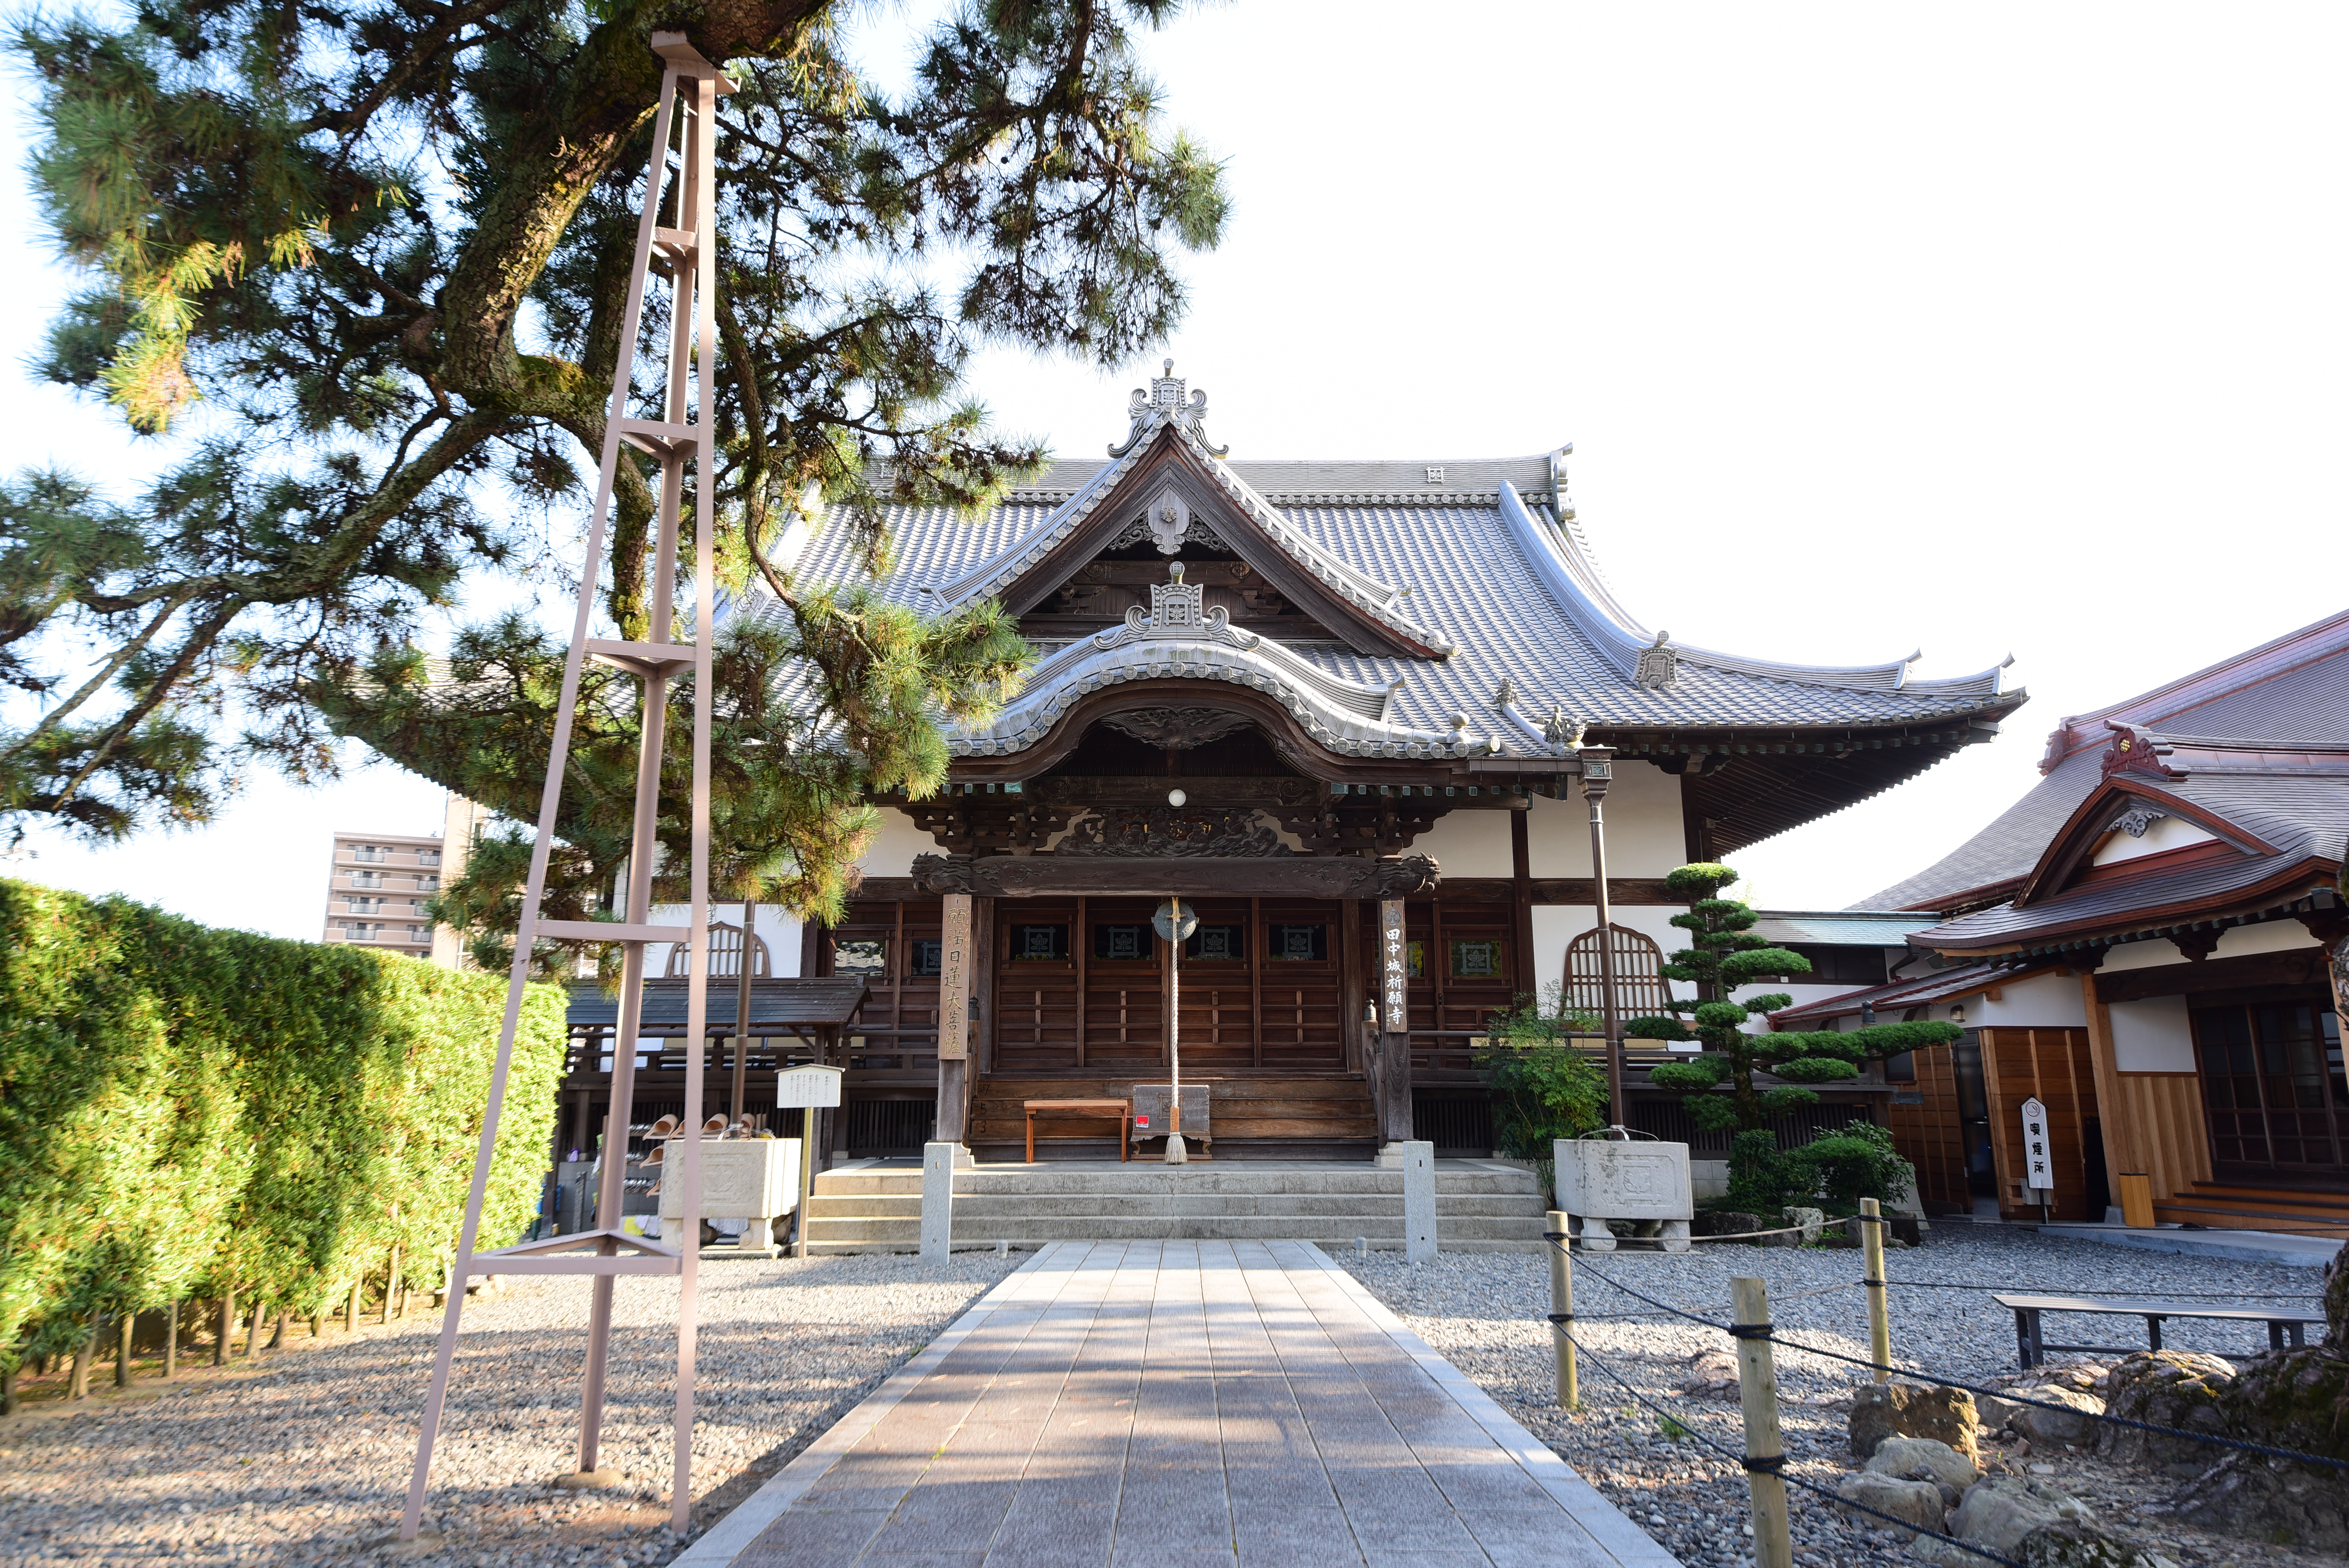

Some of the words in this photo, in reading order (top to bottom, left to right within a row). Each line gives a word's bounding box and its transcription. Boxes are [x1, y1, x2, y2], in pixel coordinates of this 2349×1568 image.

[944, 908, 966, 1054] 願満日蓮大菩薩
[1386, 928, 1403, 1025] 田中城祈願寺
[983, 1084, 990, 1096] 7
[980, 1102, 987, 1115] 5
[980, 1121, 987, 1133] 3
[2030, 1122, 2044, 1174] 喫煙所
